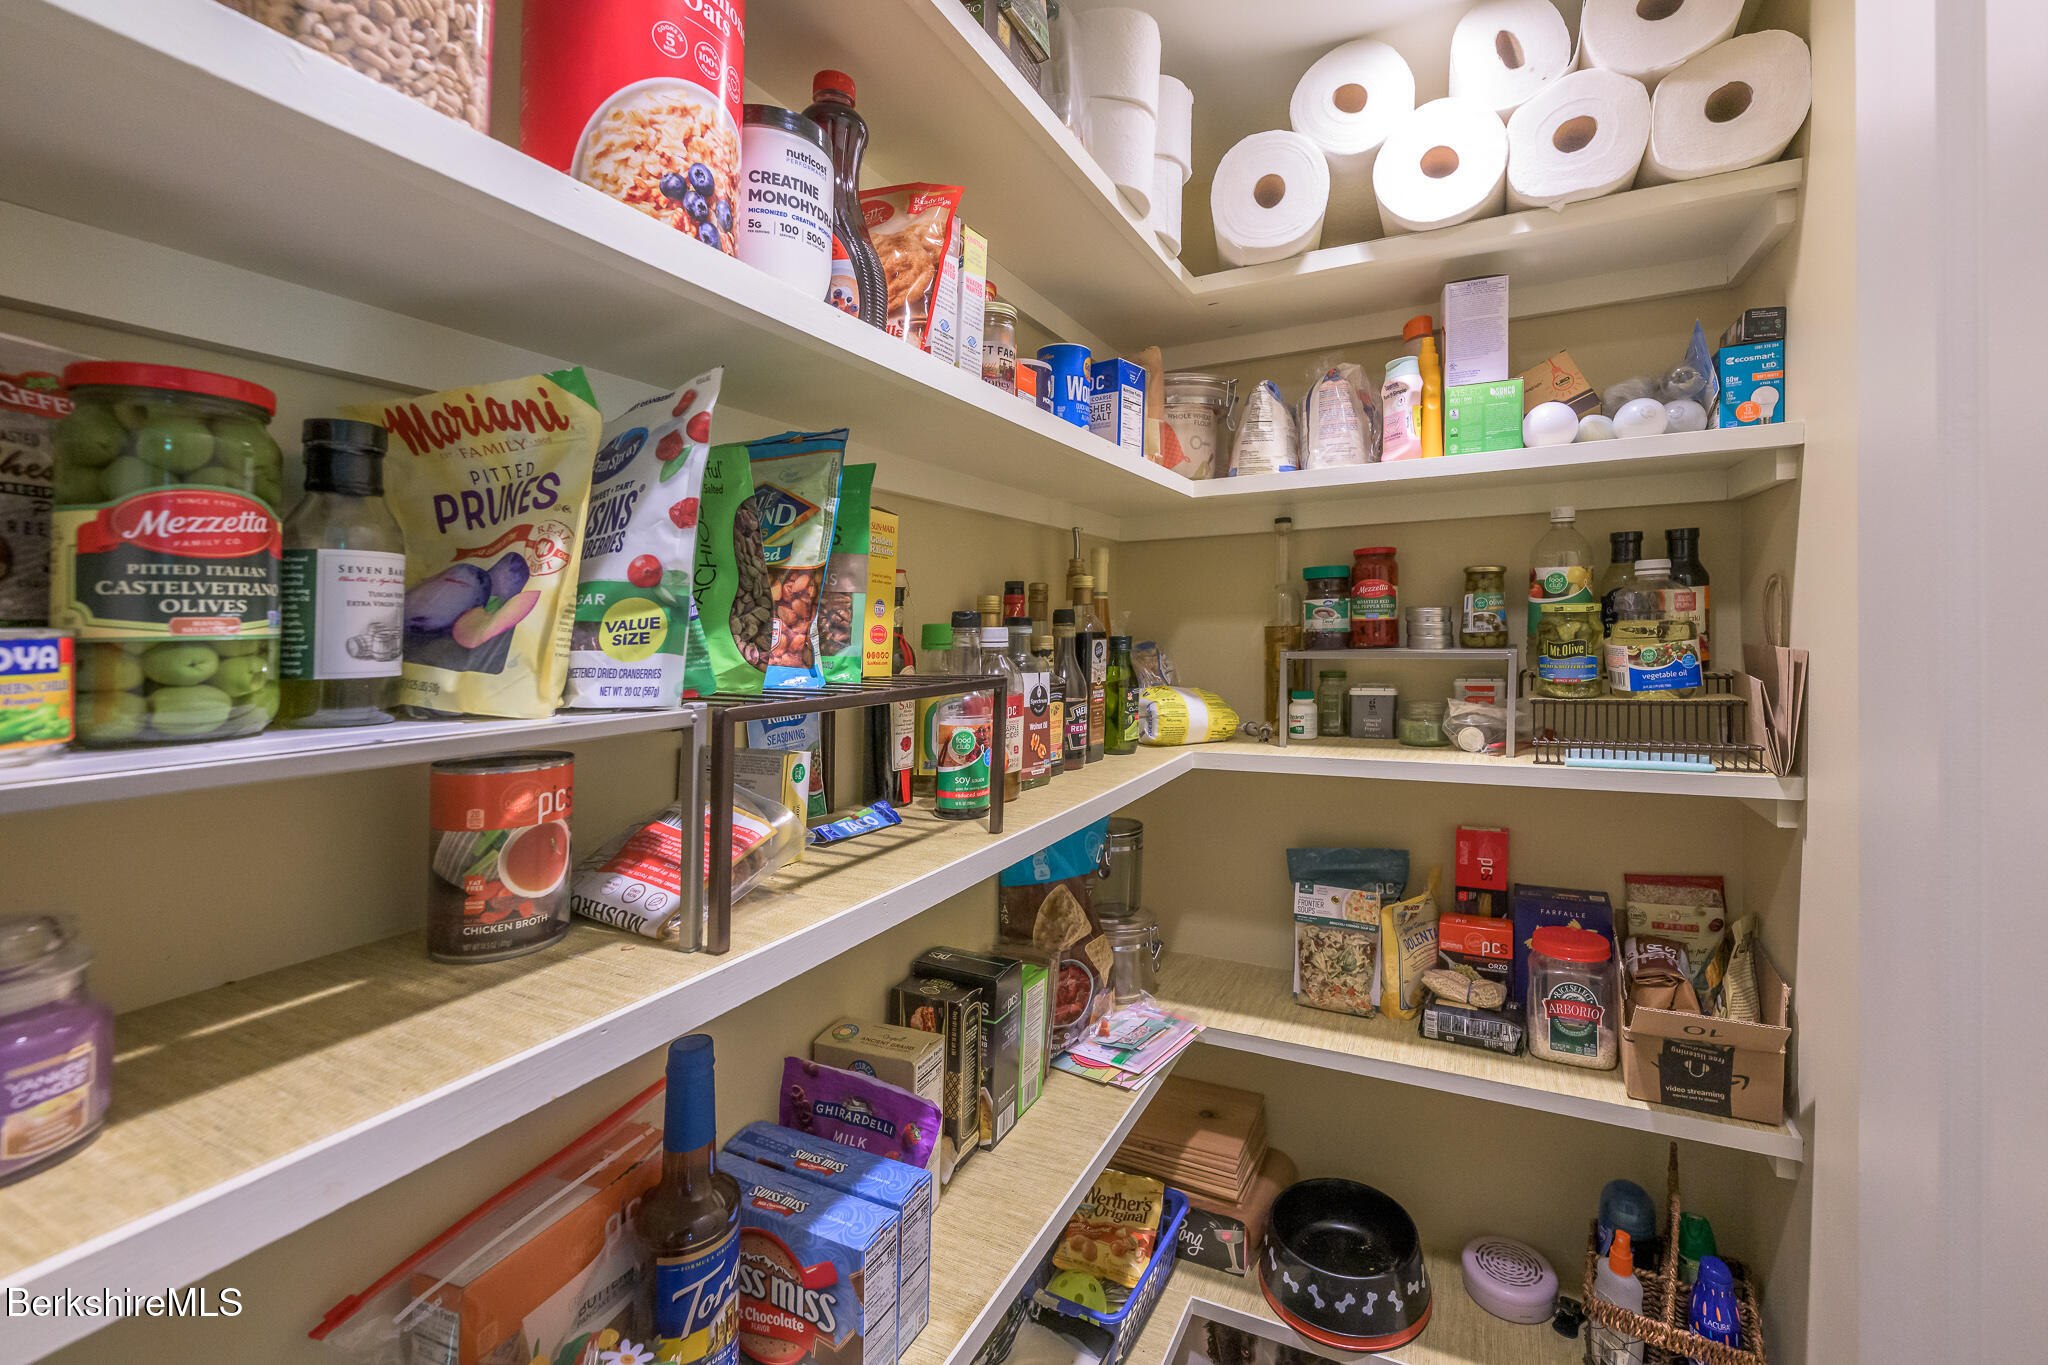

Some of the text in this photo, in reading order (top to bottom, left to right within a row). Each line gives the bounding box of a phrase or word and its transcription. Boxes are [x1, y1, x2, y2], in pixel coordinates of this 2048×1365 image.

[665, 32, 676, 47] 5
[786, 148, 827, 176] nutricost
[748, 169, 820, 201] CREATINE
[747, 207, 817, 229] MICRONIZED CREATINE
[747, 218, 826, 249] 5G 100 500G
[1734, 352, 1775, 363] ecosmart
[1762, 361, 1777, 369] LED
[382, 386, 570, 457] Mariani
[1091, 411, 1112, 423] SALT
[459, 437, 527, 459] FAMILY
[468, 461, 536, 485] PITTED
[433, 471, 561, 534] PRUNES
[121, 509, 269, 540] Mezzetta
[173, 538, 221, 547] FAMILY
[870, 536, 893, 547] Golden
[870, 545, 895, 557] Raisins
[126, 562, 267, 578] PITTED ITALIAN
[338, 564, 383, 576] SEVEN
[95, 580, 279, 598] CASTELVETRANO
[1357, 584, 1389, 594] Mezzetta
[158, 598, 248, 614] OLIVES
[346, 600, 372, 608] EXTRA
[604, 616, 661, 634] VALUE
[612, 631, 651, 647] SIZE
[1562, 643, 1584, 656] Olive
[597, 668, 662, 679] DRIED CRANBERRIES
[1642, 669, 1688, 681] vegetable oil
[600, 686, 611, 697] NET
[624, 686, 632, 697] 20
[1071, 724, 1082, 732] RED
[766, 728, 806, 747] SEASONING
[955, 736, 972, 744] food
[956, 743, 971, 751] club
[955, 776, 971, 788] soy
[837, 815, 879, 834] TACO
[468, 879, 482, 887] FAT
[1297, 899, 1325, 909] FRONTIER
[1297, 906, 1316, 915] SOUPS
[1540, 908, 1587, 919] FARFALLE
[463, 913, 549, 936] CHICKEN BROTH
[1554, 984, 1594, 1001] RICESELECT
[1548, 1003, 1600, 1020] ARBORIO
[1671, 1045, 1706, 1060] listening
[1665, 1084, 1725, 1100] video streaming
[815, 1102, 895, 1136] GHIRARDELLI
[832, 1129, 868, 1150] MILK
[1085, 1186, 1153, 1213] Werther's
[1095, 1205, 1149, 1224] Original
[745, 1306, 805, 1333] Chocolate
[1703, 1317, 1731, 1332] LACURA
[751, 1322, 770, 1334] FLAVOR
